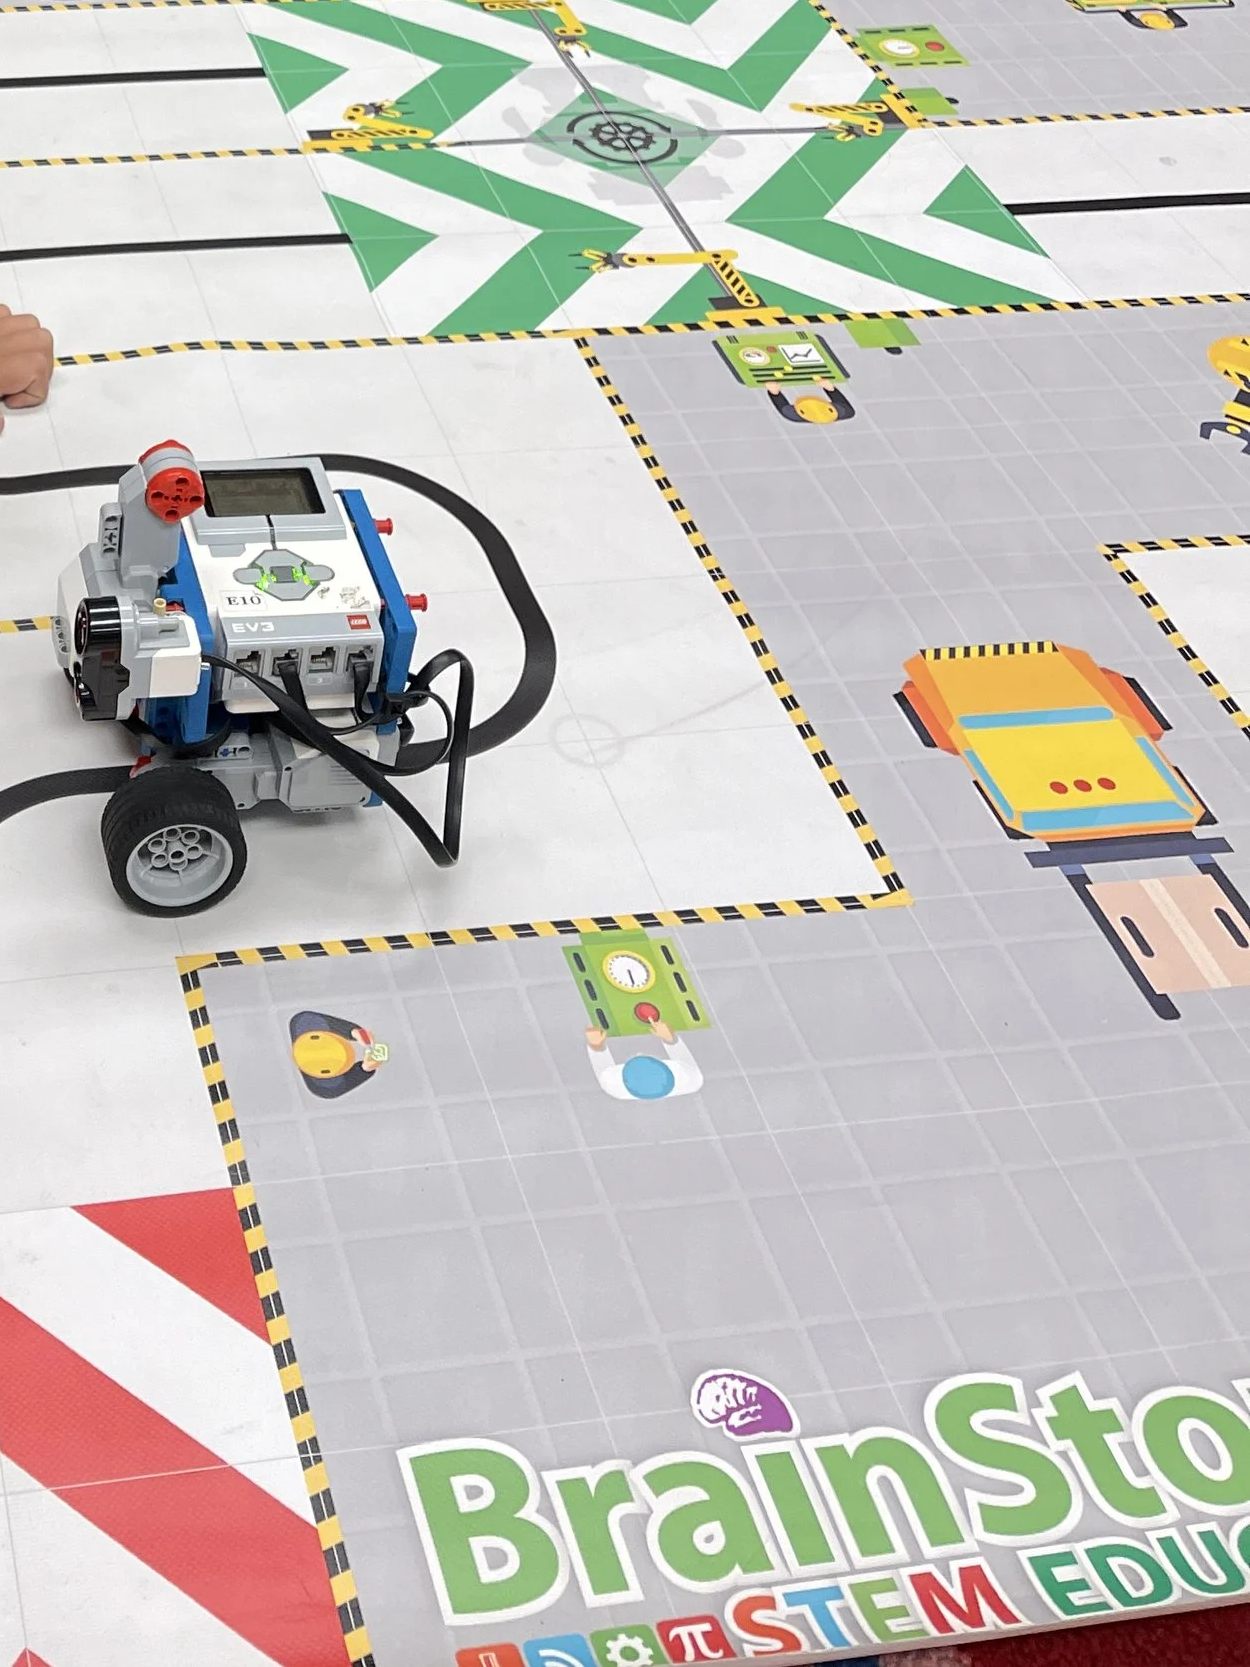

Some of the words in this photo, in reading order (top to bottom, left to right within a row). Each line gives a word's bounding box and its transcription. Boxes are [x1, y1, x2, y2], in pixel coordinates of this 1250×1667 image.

[231, 620, 275, 633] EV3
[405, 1370, 1250, 1616] BrainSto
[732, 1562, 1022, 1656] STEM
[1026, 1528, 1250, 1618] EDU
